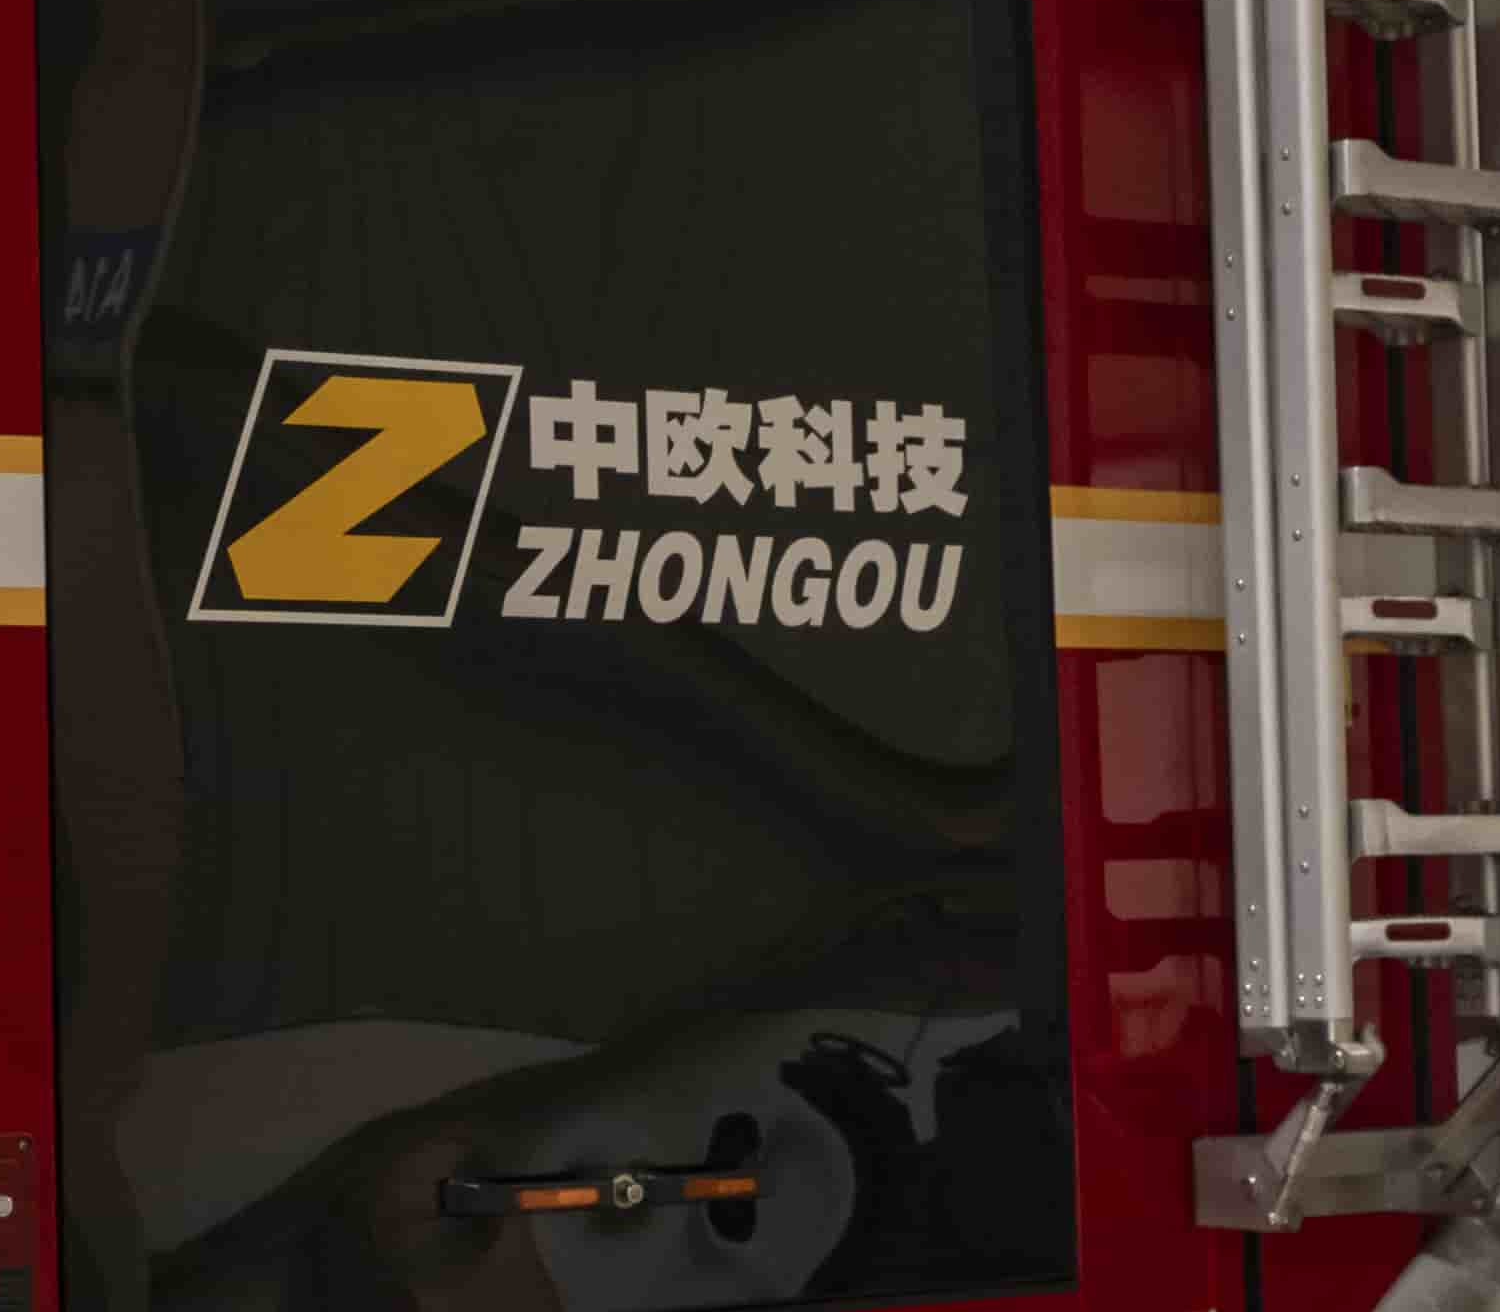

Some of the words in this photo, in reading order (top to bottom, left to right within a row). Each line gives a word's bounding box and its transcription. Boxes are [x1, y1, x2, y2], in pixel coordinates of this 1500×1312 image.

[528, 379, 969, 518] 中欧科技
[501, 525, 964, 632] ZHONGOU
